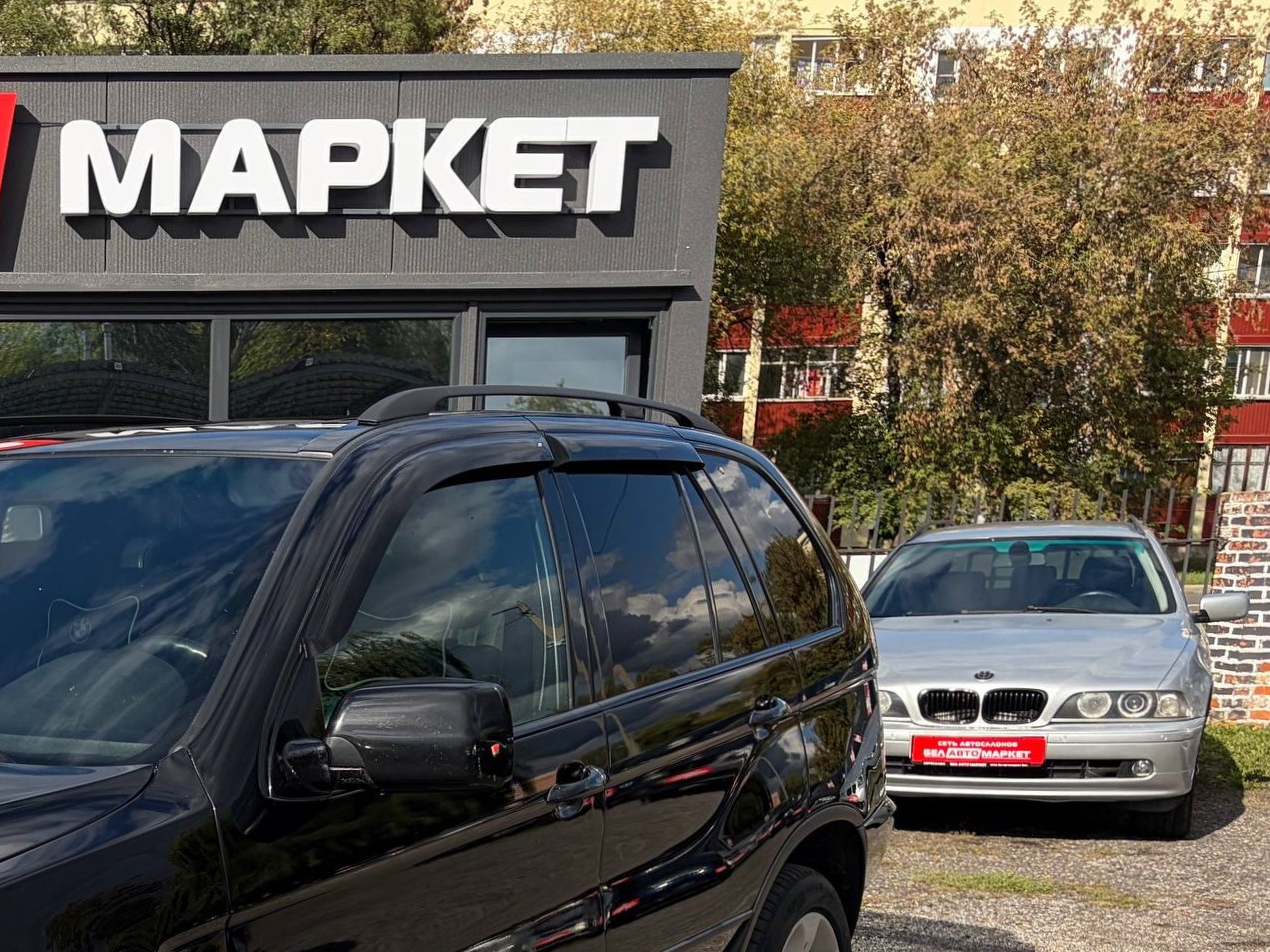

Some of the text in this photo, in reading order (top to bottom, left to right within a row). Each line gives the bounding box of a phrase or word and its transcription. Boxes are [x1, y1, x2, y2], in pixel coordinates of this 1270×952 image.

[60, 116, 660, 217] МАРКЕТ
[949, 750, 979, 758] АВТО
[981, 750, 1032, 759] МАРКЕТ
